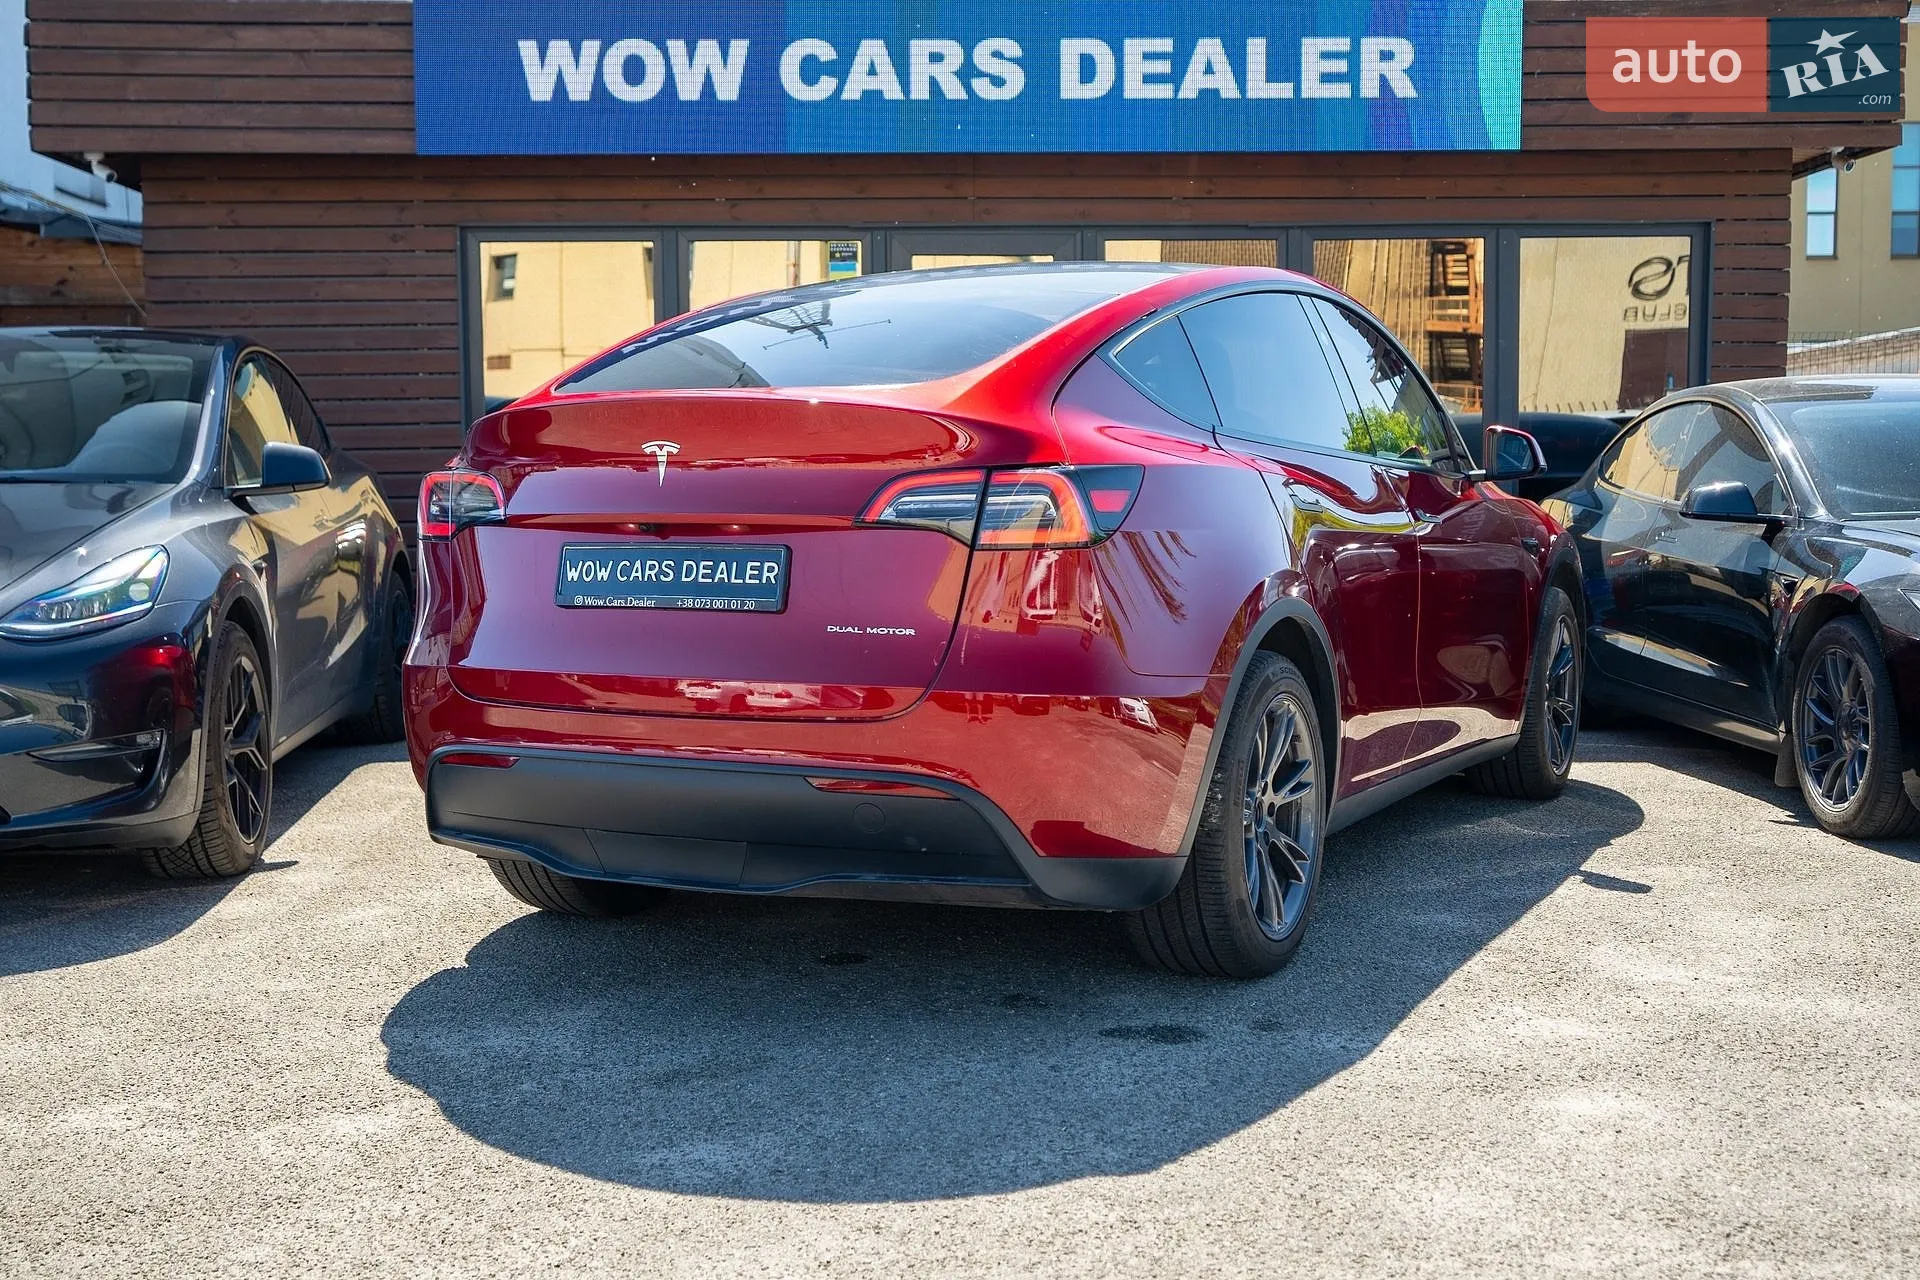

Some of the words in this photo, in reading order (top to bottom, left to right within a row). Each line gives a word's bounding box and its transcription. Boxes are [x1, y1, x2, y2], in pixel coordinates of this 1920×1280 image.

[518, 38, 749, 101] WOW
[780, 38, 1025, 101] CARS
[1060, 37, 1417, 100] DEALER
[566, 560, 613, 582] WOW
[616, 559, 675, 582] CARS
[681, 560, 779, 584] DEALER
[676, 598, 694, 609] +38
[694, 598, 711, 609] 073
[713, 599, 728, 609] 001
[730, 599, 741, 609] 01
[743, 599, 756, 610] 20
[827, 625, 863, 634] DUAL
[866, 627, 916, 636] MOTOR
